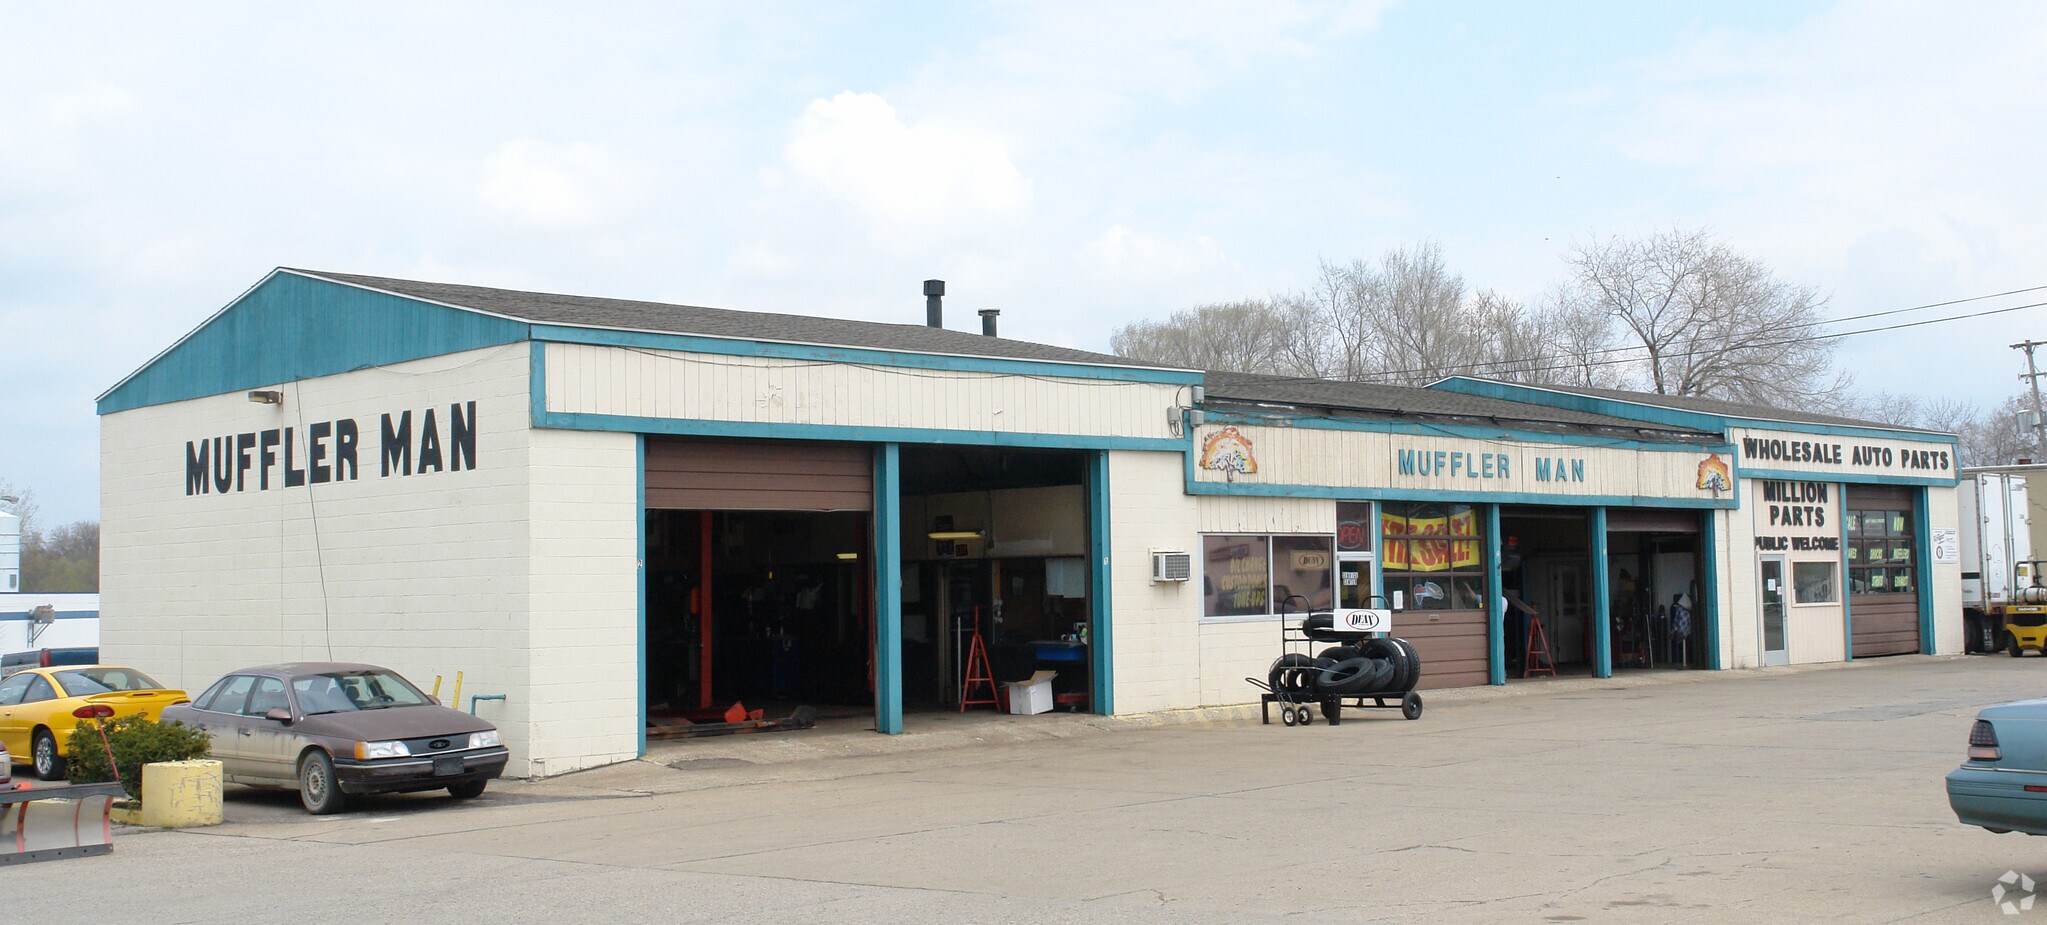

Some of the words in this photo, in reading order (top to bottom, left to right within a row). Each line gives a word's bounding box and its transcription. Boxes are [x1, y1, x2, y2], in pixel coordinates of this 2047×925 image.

[186, 418, 359, 496] MUFFLER
[380, 401, 476, 478] MAN
[1743, 437, 1842, 464] WHOLESALE
[1852, 445, 1892, 467] AUTO
[1901, 449, 1949, 470] PARTS
[1398, 449, 1510, 479] MUFFLER
[1535, 457, 1584, 482] MAN
[1763, 481, 1828, 503] MILLION
[1769, 505, 1825, 527] PARTS
[1337, 526, 1365, 544] OPEN
[1418, 516, 1471, 566] SALE!
[1755, 536, 1788, 551] PUBLIC
[1791, 537, 1839, 551] WELCOME
